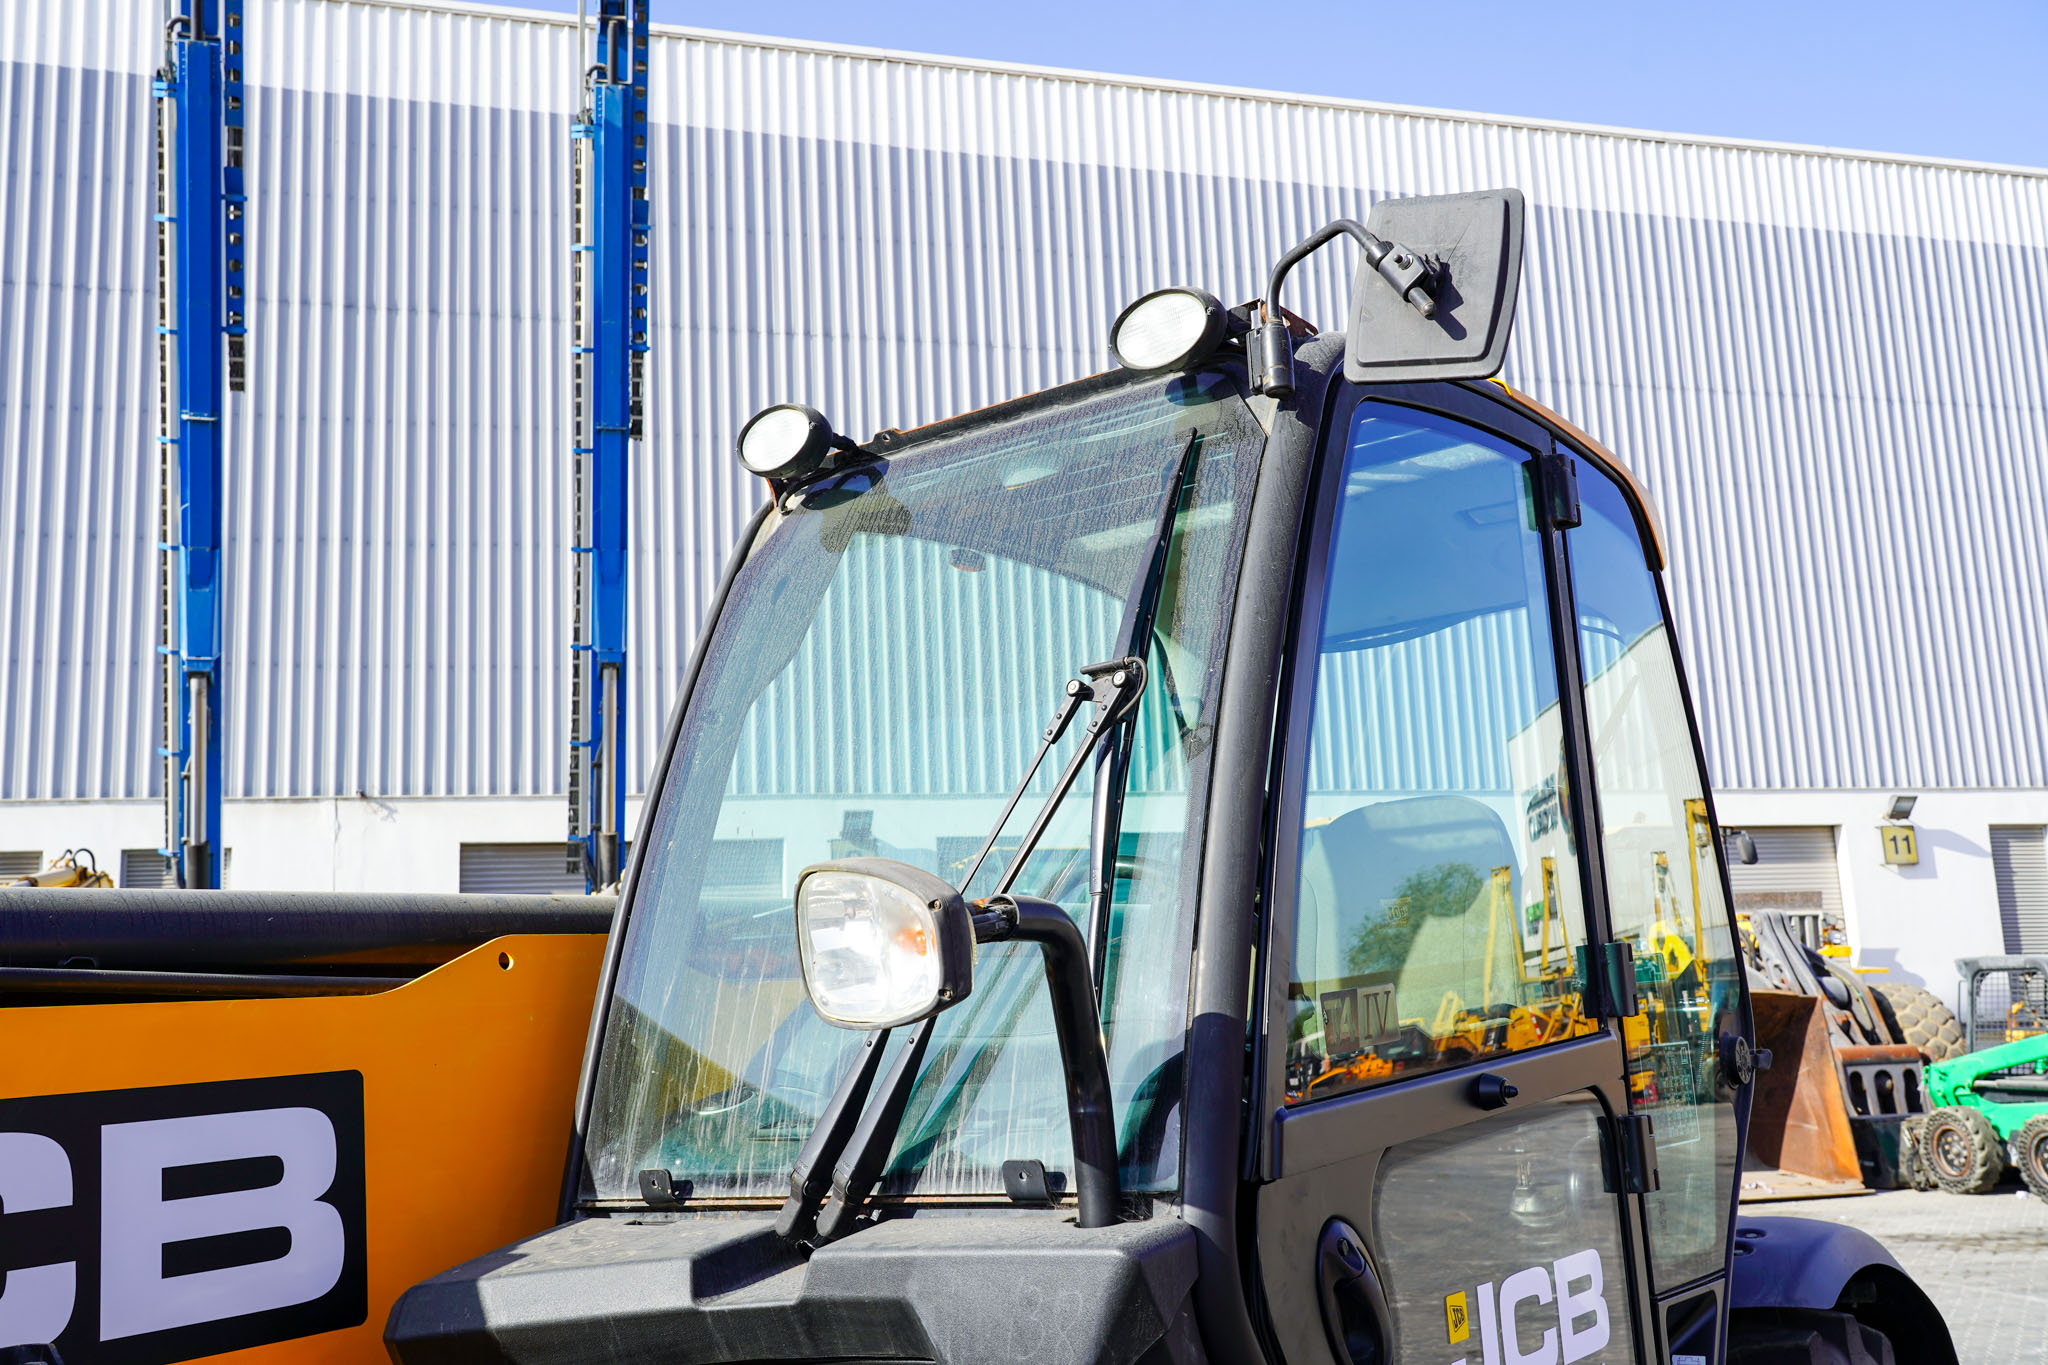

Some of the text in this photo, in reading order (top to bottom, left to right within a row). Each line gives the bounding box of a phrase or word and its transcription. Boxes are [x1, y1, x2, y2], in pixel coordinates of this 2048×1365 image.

[1889, 835, 1911, 855] 11
[1363, 990, 1392, 1040] IV
[1451, 1249, 1610, 1365] JCB
[1452, 1307, 1465, 1329] JCB
